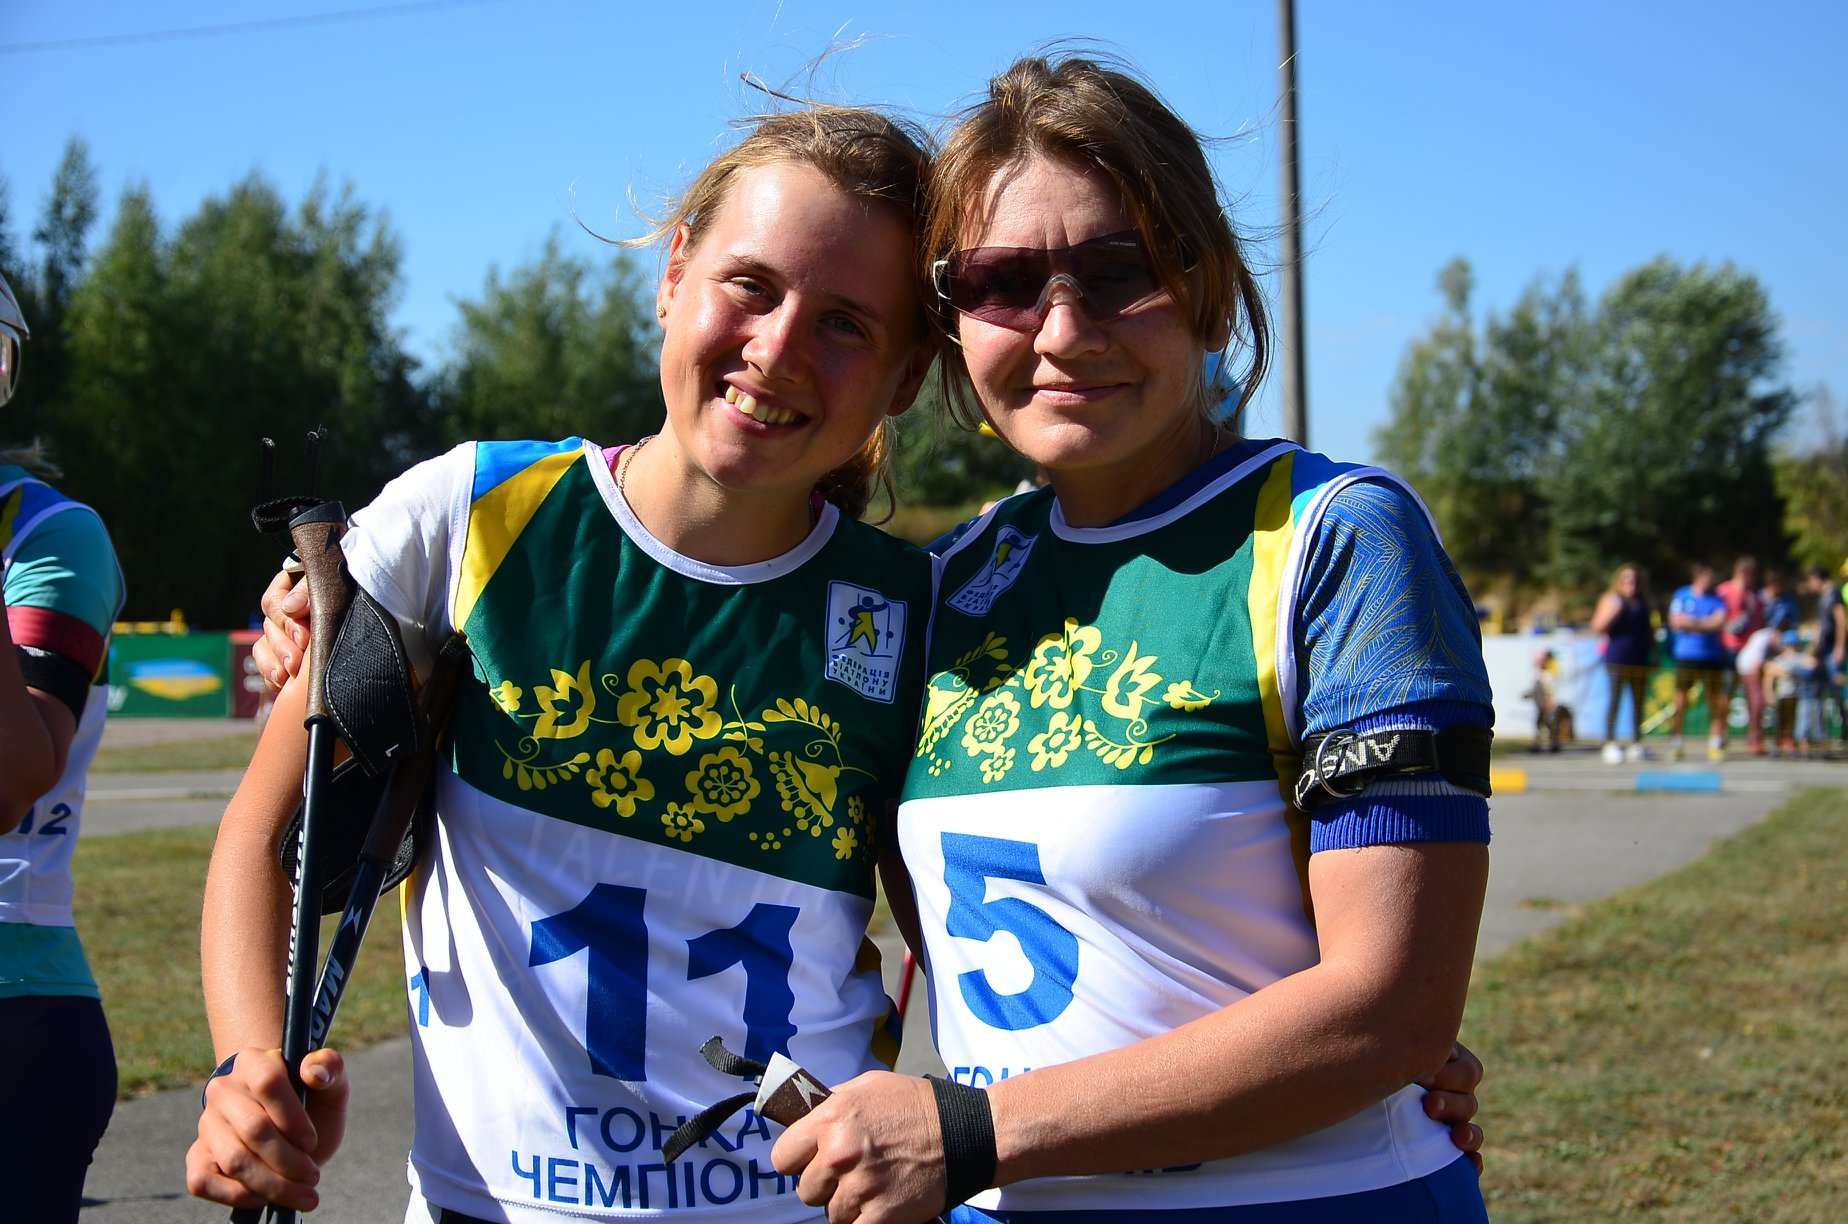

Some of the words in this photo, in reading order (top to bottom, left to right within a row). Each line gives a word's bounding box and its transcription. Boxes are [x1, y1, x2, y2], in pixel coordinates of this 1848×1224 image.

[529, 882, 800, 1082] 11
[940, 831, 1080, 1031] 5
[511, 1150, 800, 1209] ЧЕМПІОН
